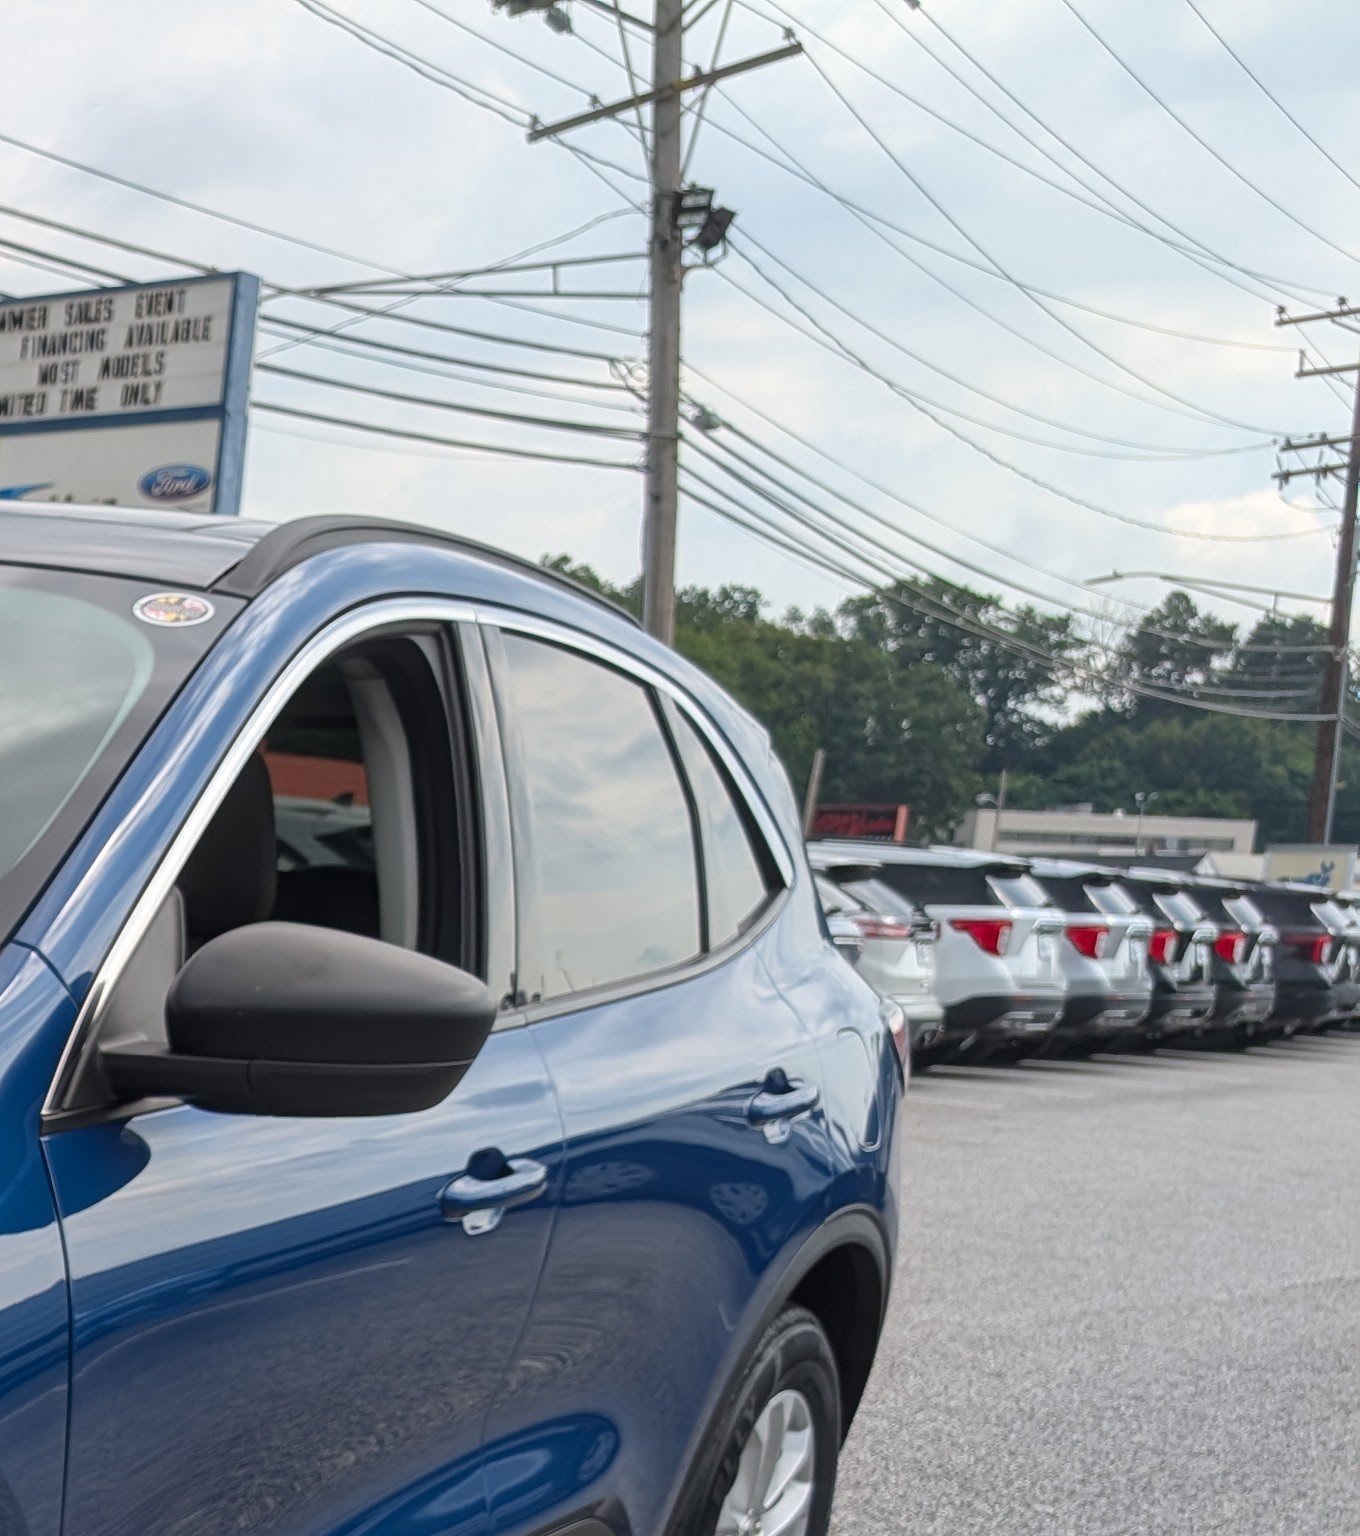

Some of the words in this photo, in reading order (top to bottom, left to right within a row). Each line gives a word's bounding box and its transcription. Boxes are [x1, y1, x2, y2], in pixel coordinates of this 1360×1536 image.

[64, 298, 114, 326] SALES
[135, 290, 187, 319] EVENT
[20, 328, 108, 360] FINANCING
[123, 315, 215, 349] AVAILABLE
[37, 360, 80, 387] MOST
[98, 351, 167, 380] MODELS
[59, 386, 98, 412] TIME
[120, 381, 164, 406] ONLY
